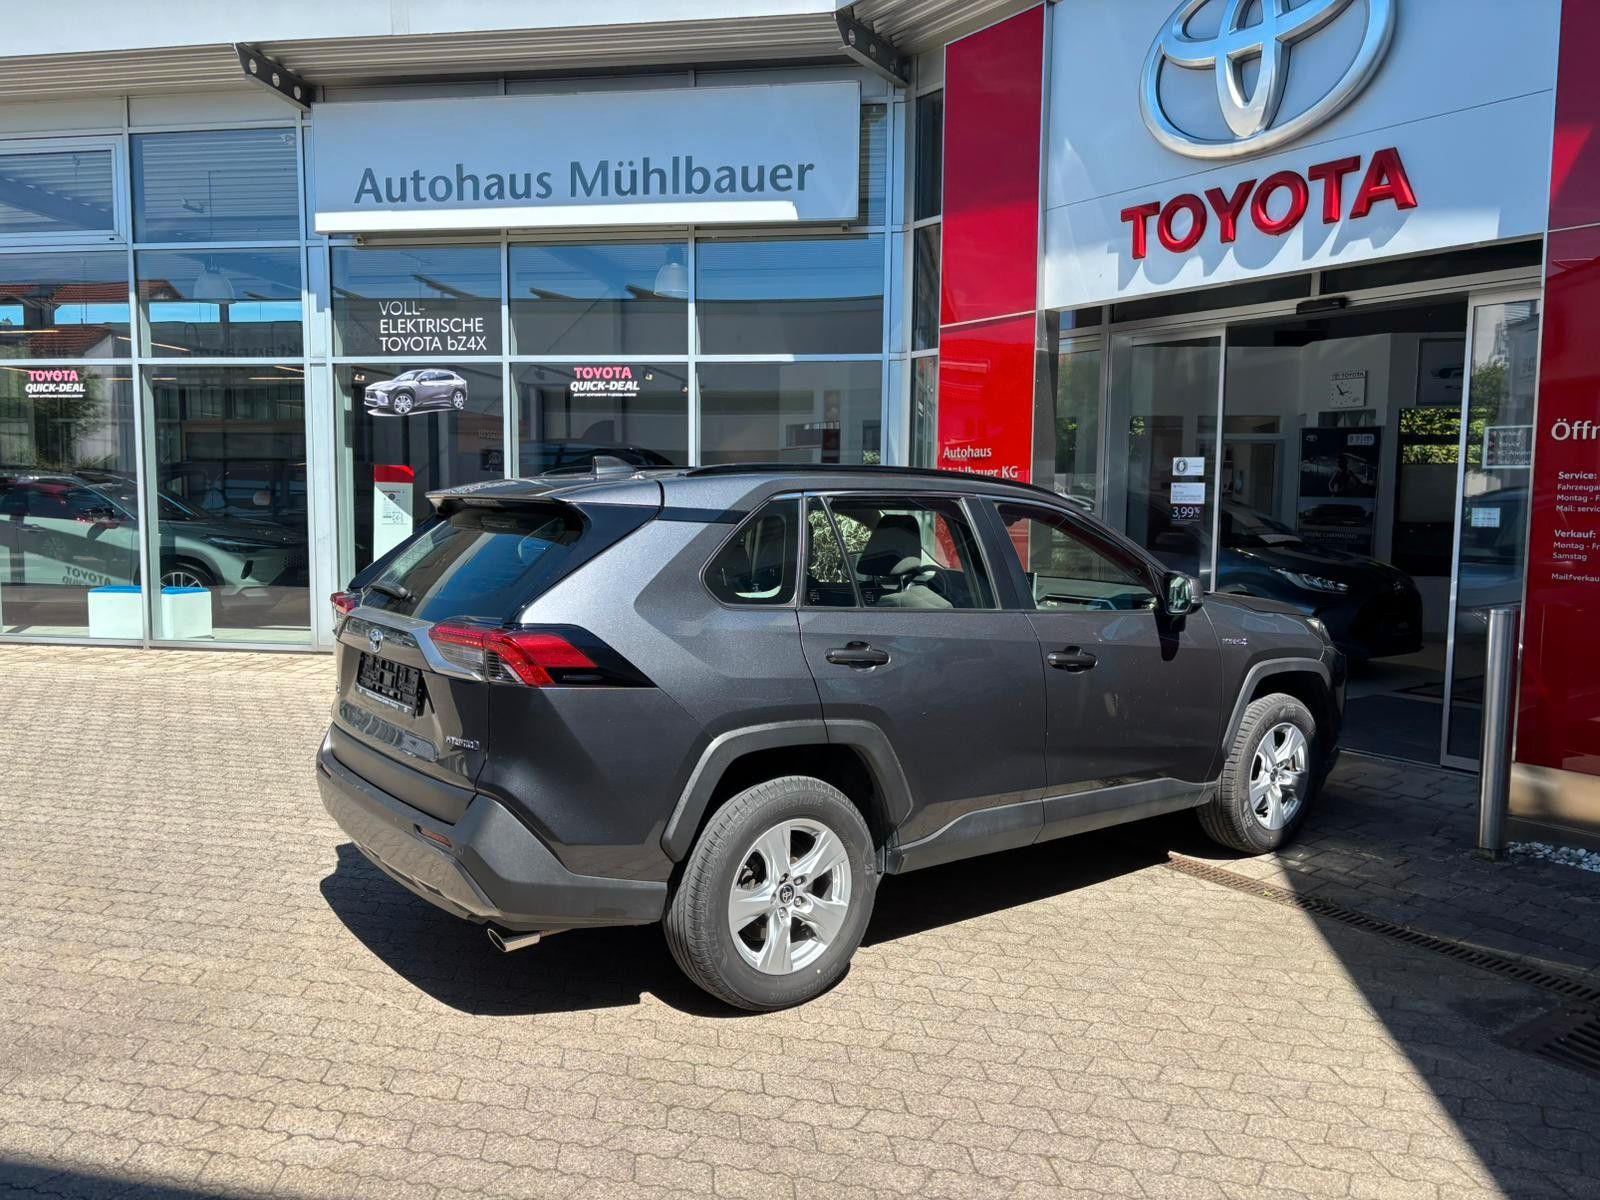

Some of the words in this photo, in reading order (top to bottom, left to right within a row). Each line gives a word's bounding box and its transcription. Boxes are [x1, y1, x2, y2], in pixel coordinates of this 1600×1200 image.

[353, 163, 553, 204] Autohaus
[569, 155, 815, 198] Mühlbauer
[1120, 146, 1418, 260] TOYOTA
[379, 301, 426, 316] VOLL-
[380, 317, 485, 334] ELEKTRISCHE
[379, 336, 443, 352] TOYOTA
[447, 335, 488, 351] bZ4X
[29, 369, 79, 382] TOYOTA
[573, 366, 633, 380] TOYOTA
[25, 383, 86, 394] QUICK-DEAL
[570, 380, 640, 393] QUICK-DEAL
[943, 445, 992, 458] Autohaus
[1001, 466, 1018, 478] KG
[1558, 471, 1597, 480] Service:
[1554, 529, 1596, 538] Verkauf:
[1553, 542, 1585, 550] Montag
[1552, 552, 1587, 561] Samstag
[65, 566, 111, 586] TOYOTA
